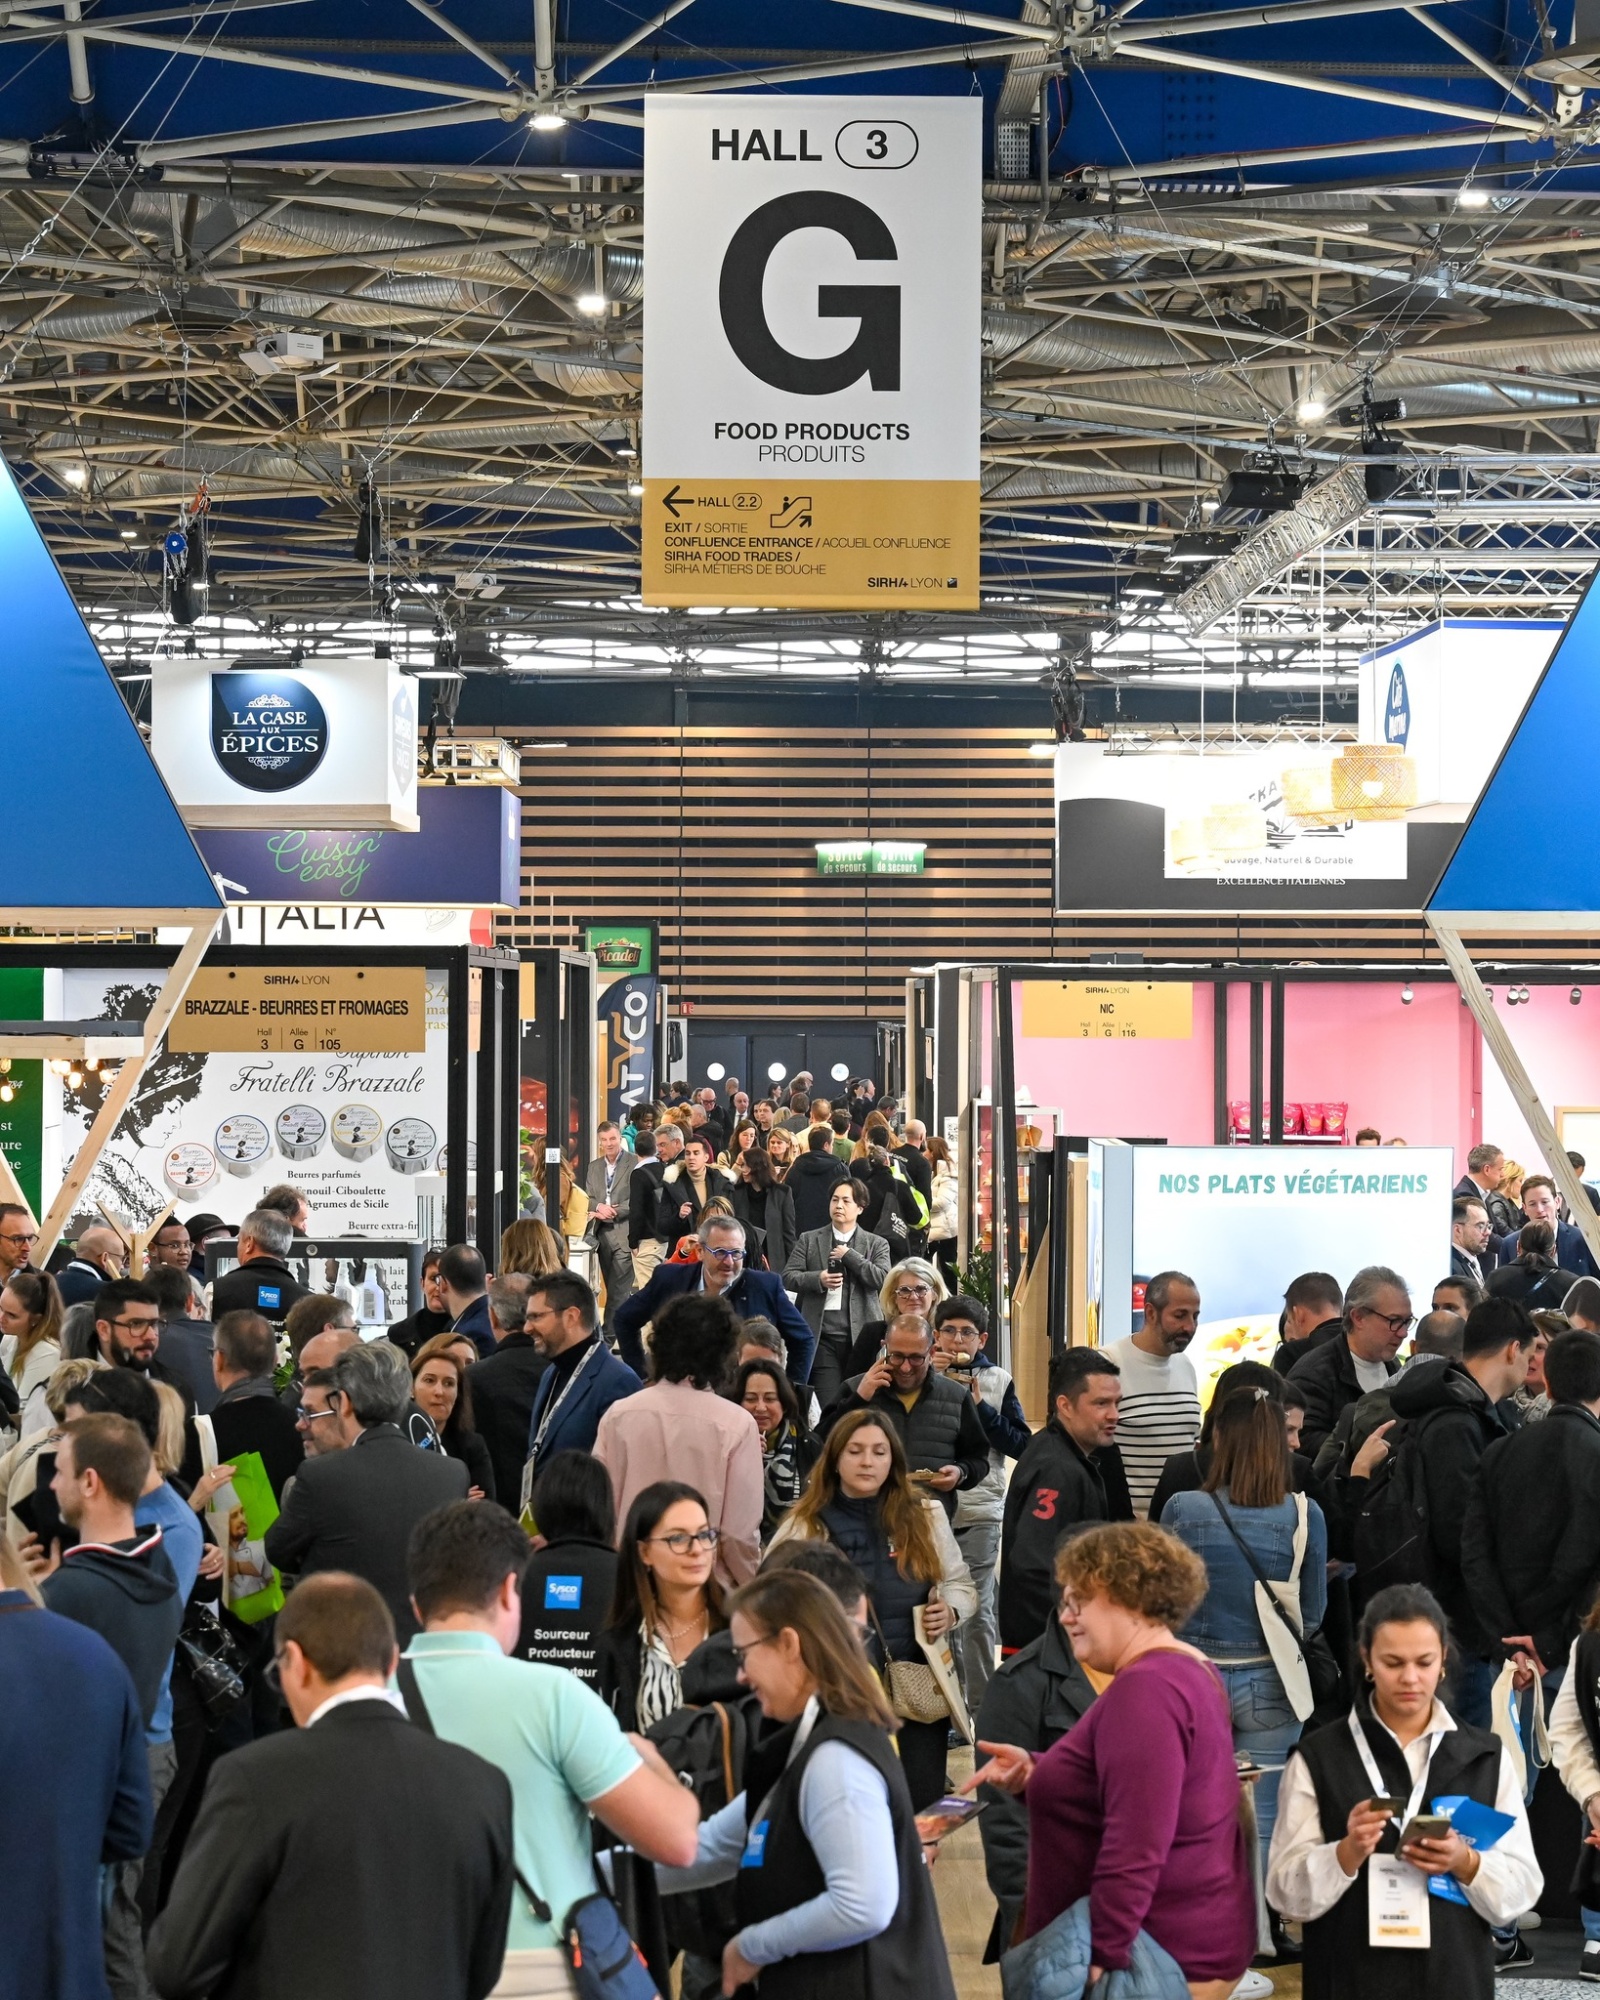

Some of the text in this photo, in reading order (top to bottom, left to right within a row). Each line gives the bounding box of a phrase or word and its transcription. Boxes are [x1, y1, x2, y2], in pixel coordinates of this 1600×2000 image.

[711, 128, 889, 161] HALL 3
[719, 190, 902, 396] G
[714, 422, 910, 441] FOOD PRODUCTS
[758, 445, 866, 463] PRODUITS
[697, 496, 758, 508] HALL 2.2
[664, 522, 693, 533] EXIT
[703, 522, 748, 533] SORTIE
[664, 536, 746, 548] CONFLUENCE
[748, 537, 814, 548] ENTRANCE
[821, 537, 871, 549] ACCUEIL
[873, 537, 951, 549] CONFLUENCE
[664, 550, 702, 562] SIRHA
[705, 551, 742, 562] FOOD
[743, 551, 793, 562] TRADES
[664, 560, 827, 575] SIRHA MÉTIERS DE BOUCHE
[910, 577, 943, 588] LYON
[232, 711, 308, 726] LA CASE
[260, 726, 280, 734] AUX
[220, 732, 319, 753] ÉPICES
[1265, 856, 1303, 864] Naturel
[1305, 856, 1312, 864] &
[1314, 856, 1354, 864] Durable
[823, 862, 867, 874] de secours
[877, 861, 918, 873] de secours
[299, 859, 371, 897] easy
[1216, 877, 1286, 886] EXCELLENCE
[301, 975, 330, 985] LYON
[185, 999, 250, 1016] BRAZZALE
[259, 999, 318, 1016] BEURRES
[320, 999, 337, 1016] ET
[338, 999, 409, 1016] FROMAGES
[256, 1027, 273, 1037] Hall
[289, 1027, 309, 1037] Allée
[1082, 1029, 1137, 1038] 3 G 116
[260, 1039, 342, 1051] 3 G 105
[606, 990, 649, 1131] ATYCO
[229, 1060, 427, 1094] Fratelli Brazzale
[287, 1170, 362, 1181] Beurres parfumés
[1158, 1168, 1428, 1195] NOS PLATS VÉGÉTARIENS
[306, 1199, 390, 1211] Agrumes de Sicile
[348, 1220, 380, 1230] Beurre
[389, 1266, 405, 1275] lait
[390, 1281, 402, 1290] de
[1032, 1488, 1060, 1520] 3
[549, 1583, 578, 1594] Sysco
[533, 1628, 591, 1641] Sourceur
[528, 1647, 597, 1660] Producteur
